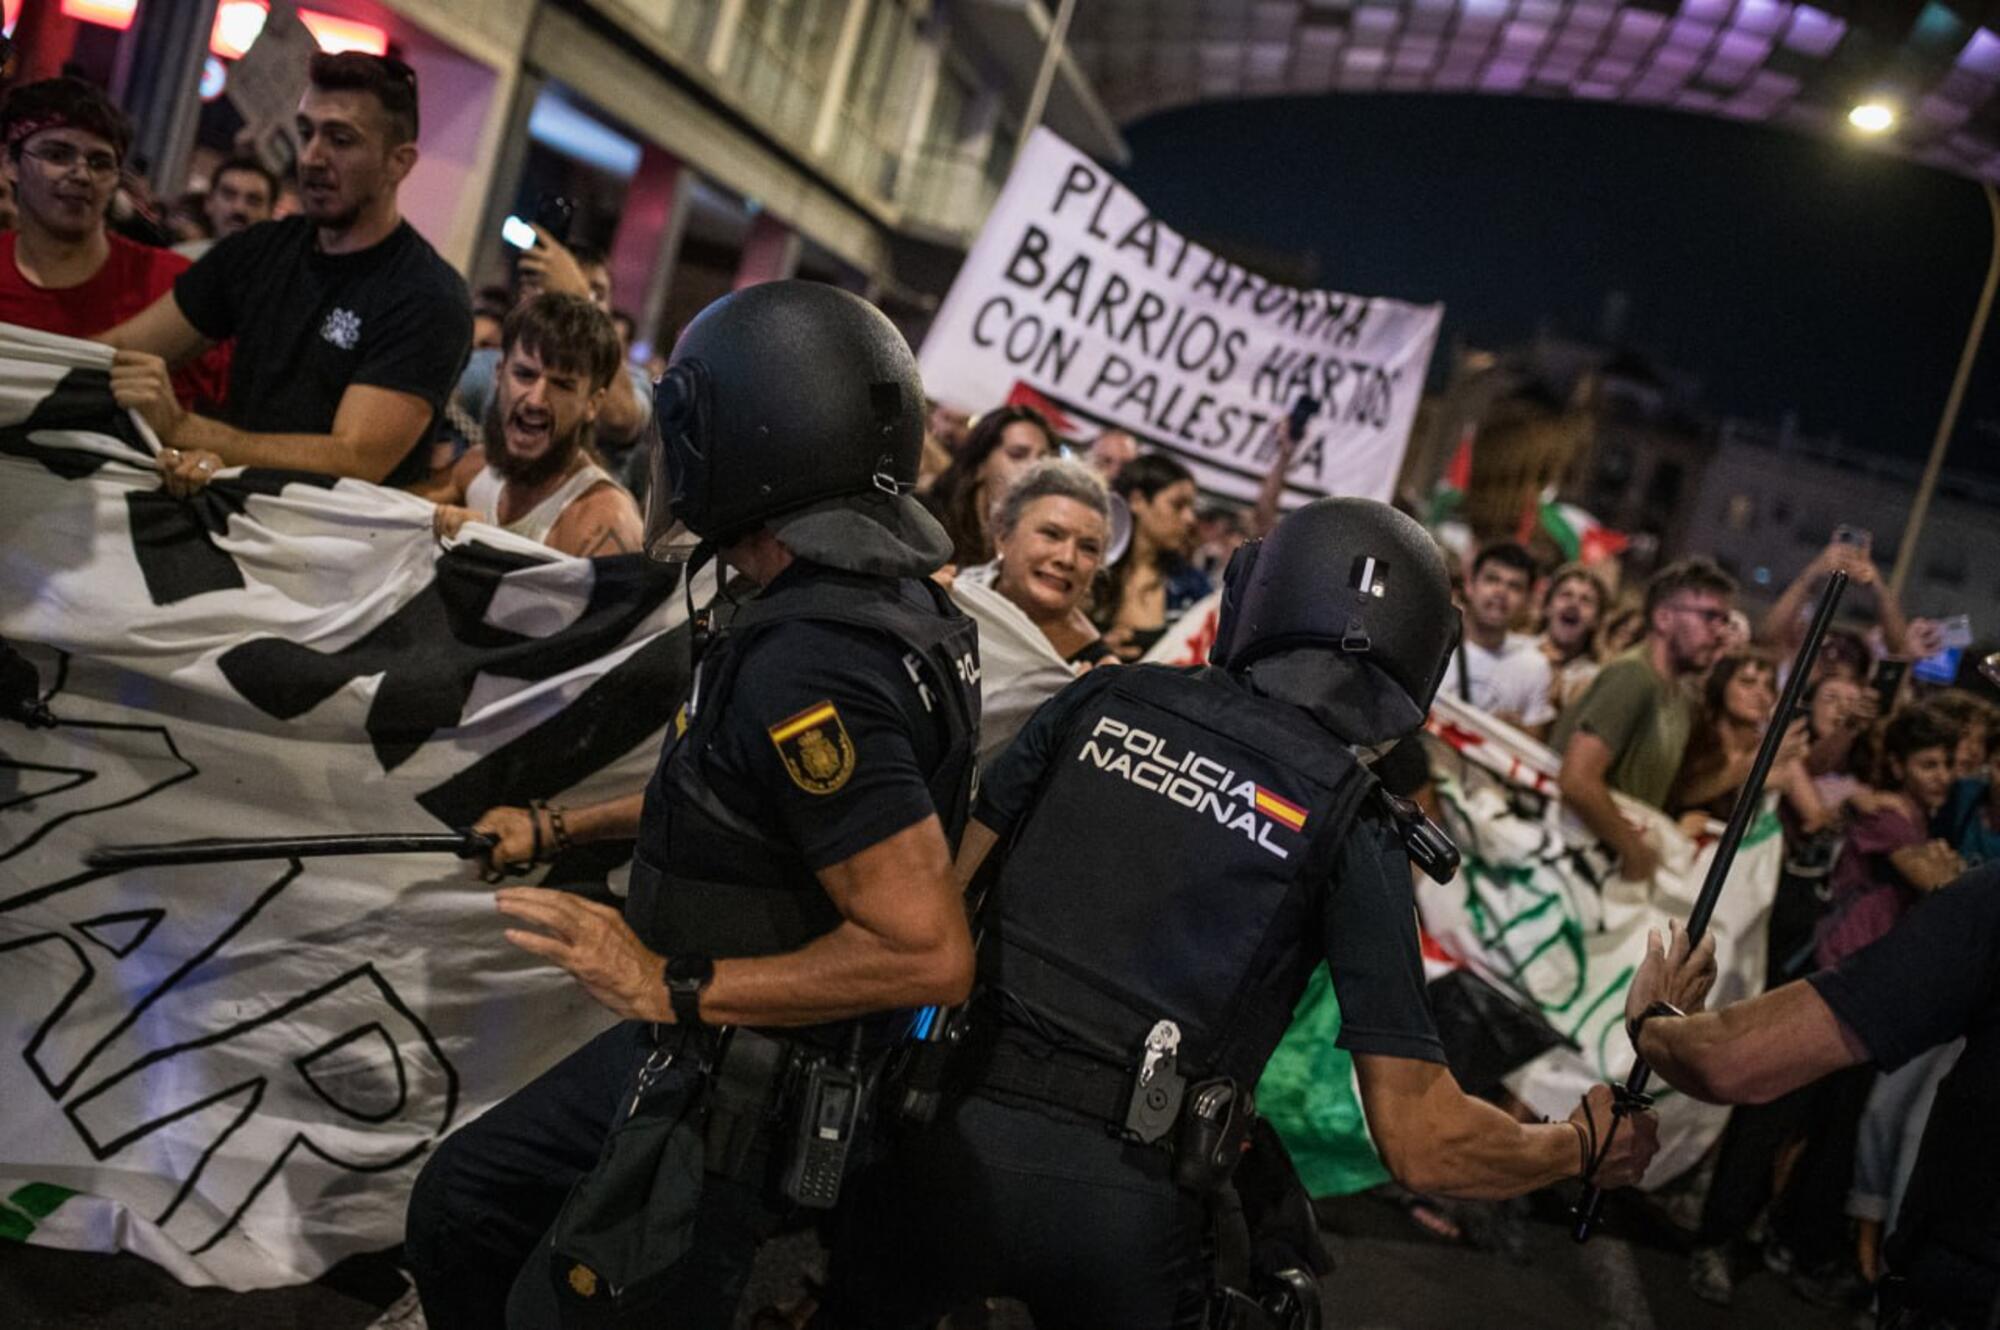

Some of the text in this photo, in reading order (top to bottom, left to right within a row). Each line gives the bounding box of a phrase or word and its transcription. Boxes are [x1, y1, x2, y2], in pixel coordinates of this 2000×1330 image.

[972, 296, 1081, 386] CON
[1005, 226, 1248, 383] BARRIOS
[1078, 740, 1289, 860] NACIONAL
[1092, 716, 1256, 809] POLICIA
